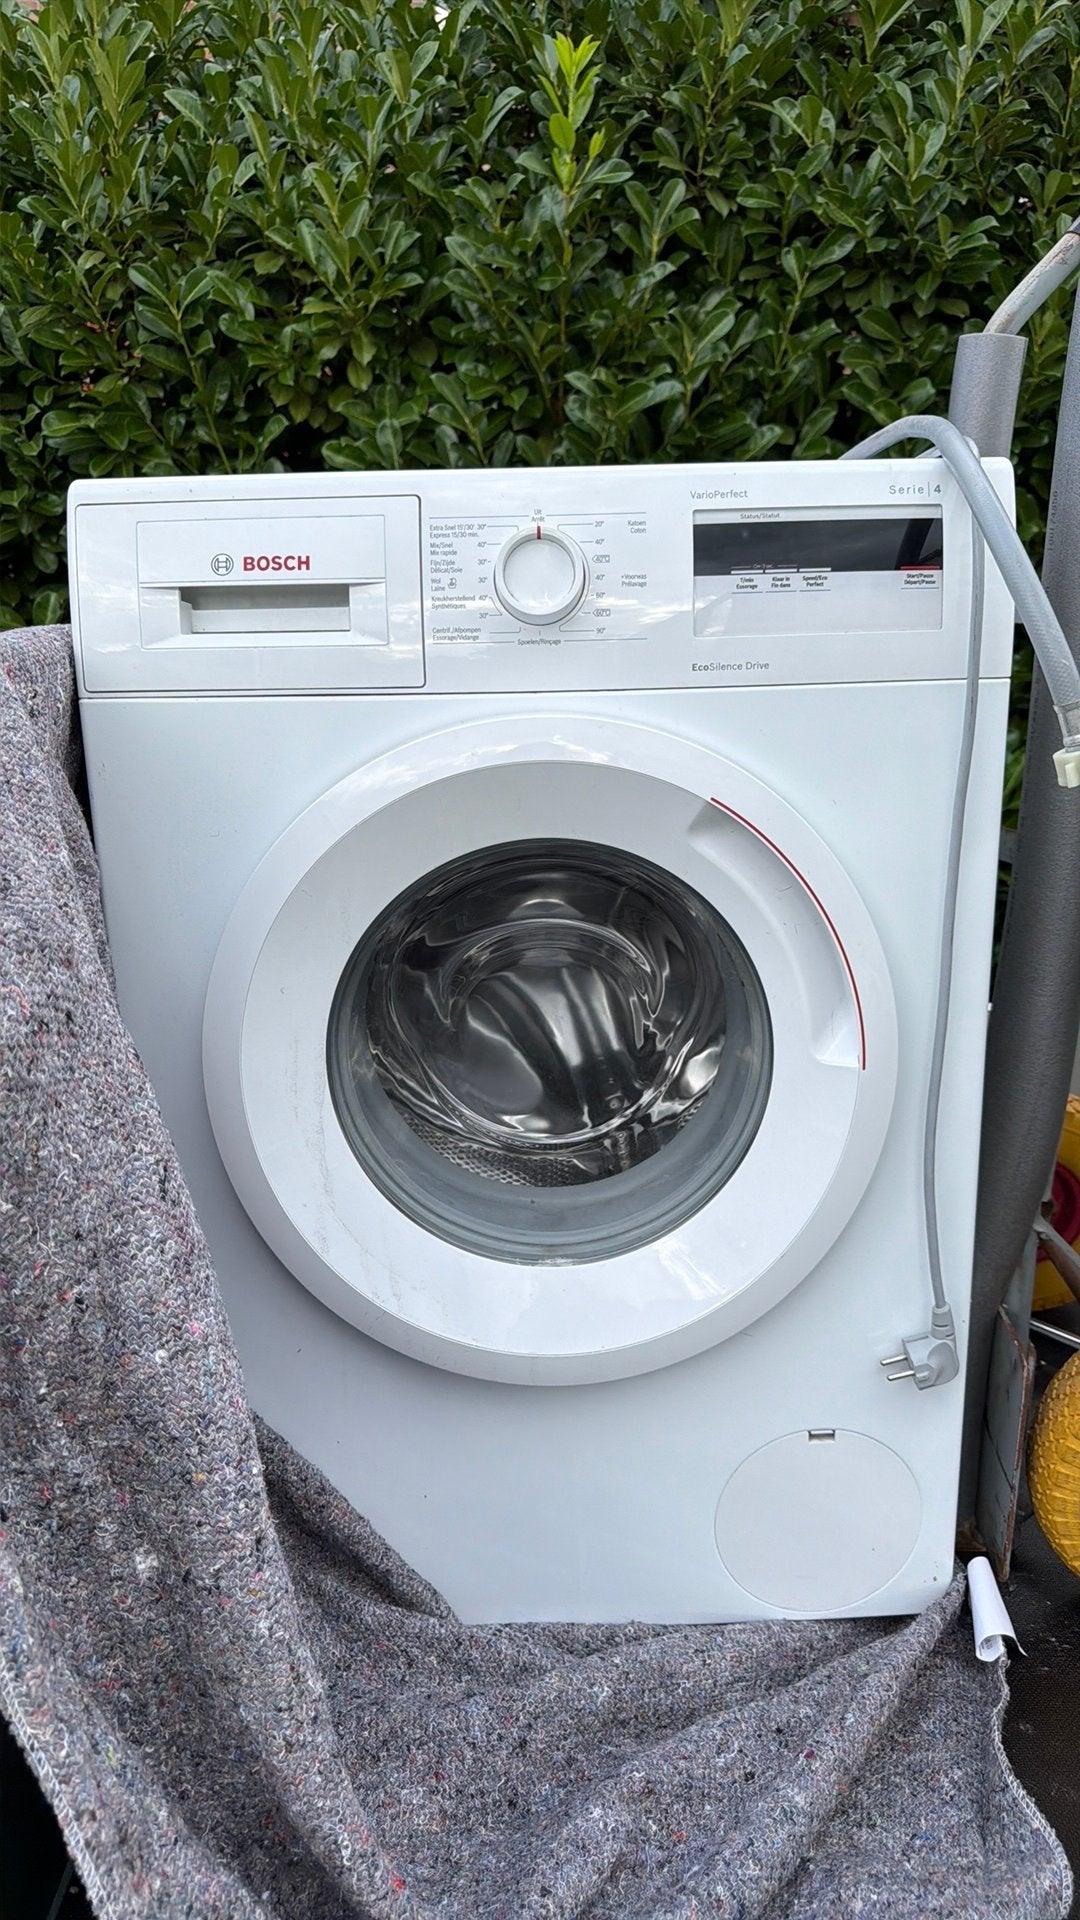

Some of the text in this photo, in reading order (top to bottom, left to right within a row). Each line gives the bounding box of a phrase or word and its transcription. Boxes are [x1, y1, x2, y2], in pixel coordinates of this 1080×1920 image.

[889, 484, 942, 495] Serie 4
[690, 490, 748, 500] VarioPerfect
[740, 512, 780, 520] Status/Statut
[243, 555, 310, 571] BOSCH
[691, 661, 770, 671] EcoSilence Drive
